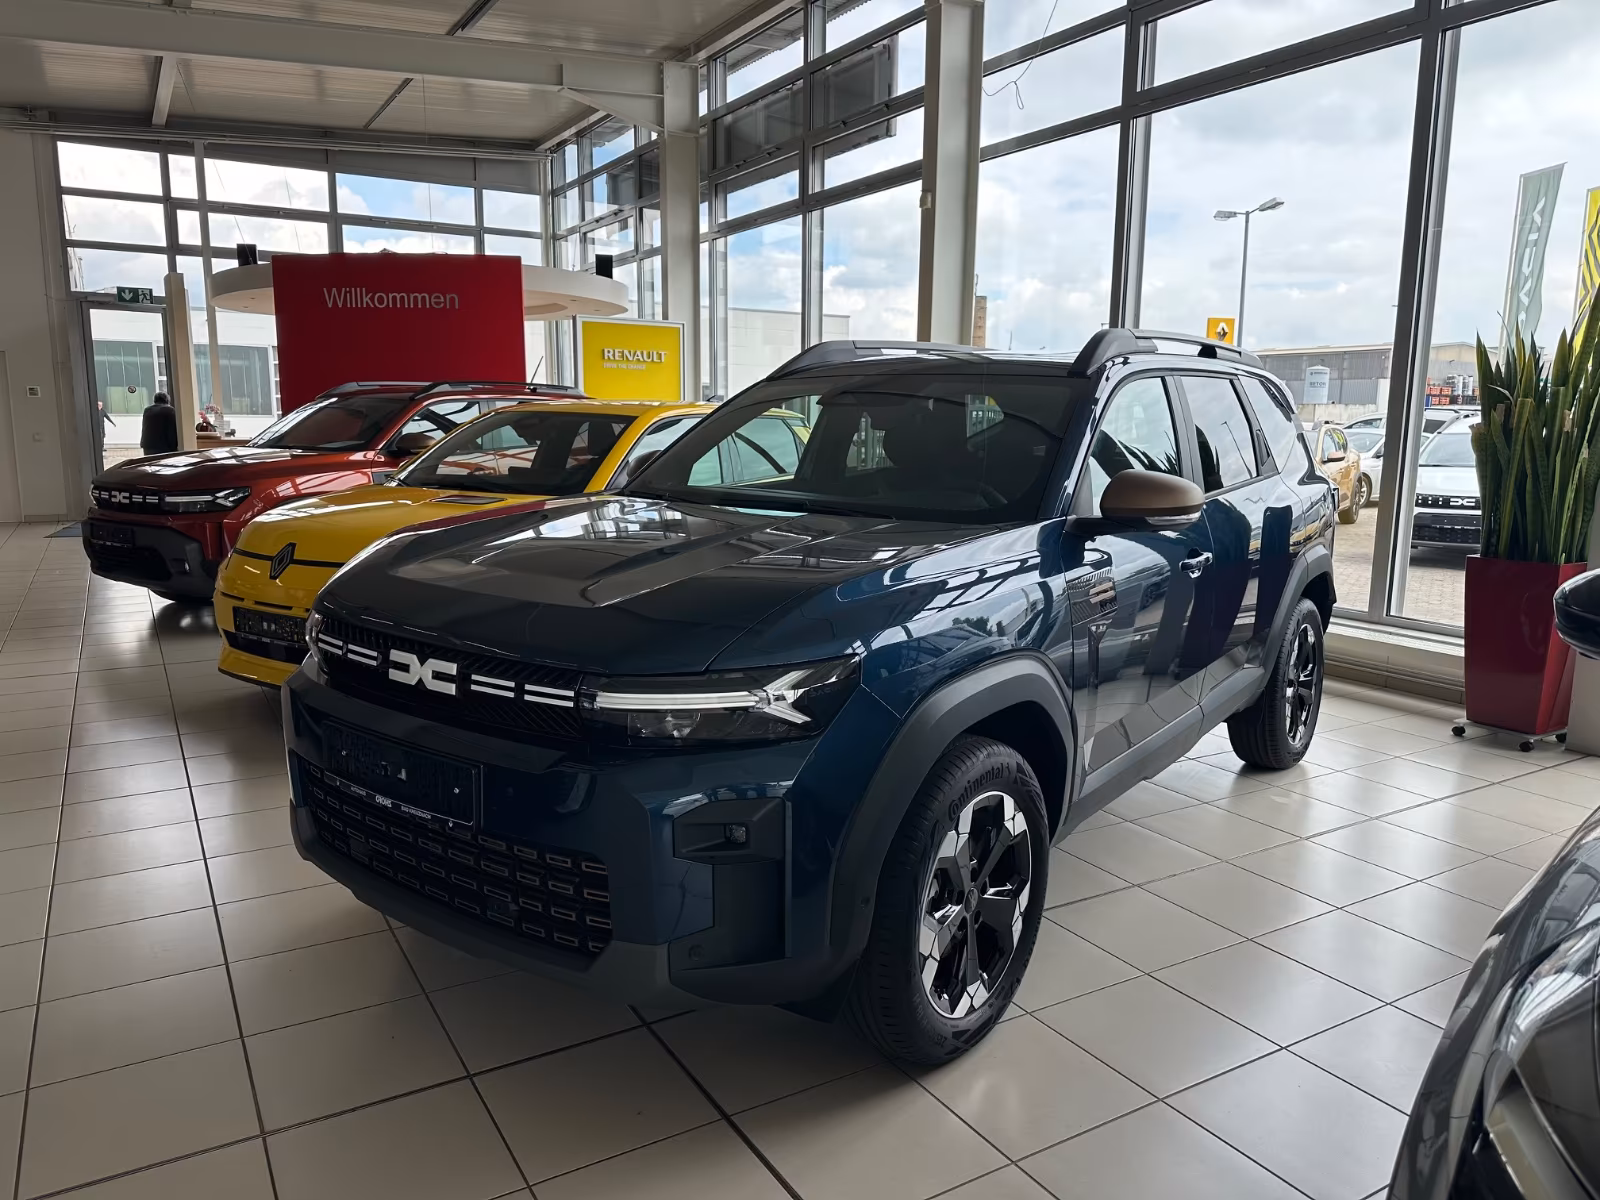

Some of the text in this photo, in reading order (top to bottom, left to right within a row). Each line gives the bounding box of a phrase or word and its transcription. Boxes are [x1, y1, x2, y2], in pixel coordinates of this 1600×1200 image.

[323, 287, 459, 309] Willkommen
[602, 348, 668, 363] RENAULT
[948, 762, 1004, 822] Continental
